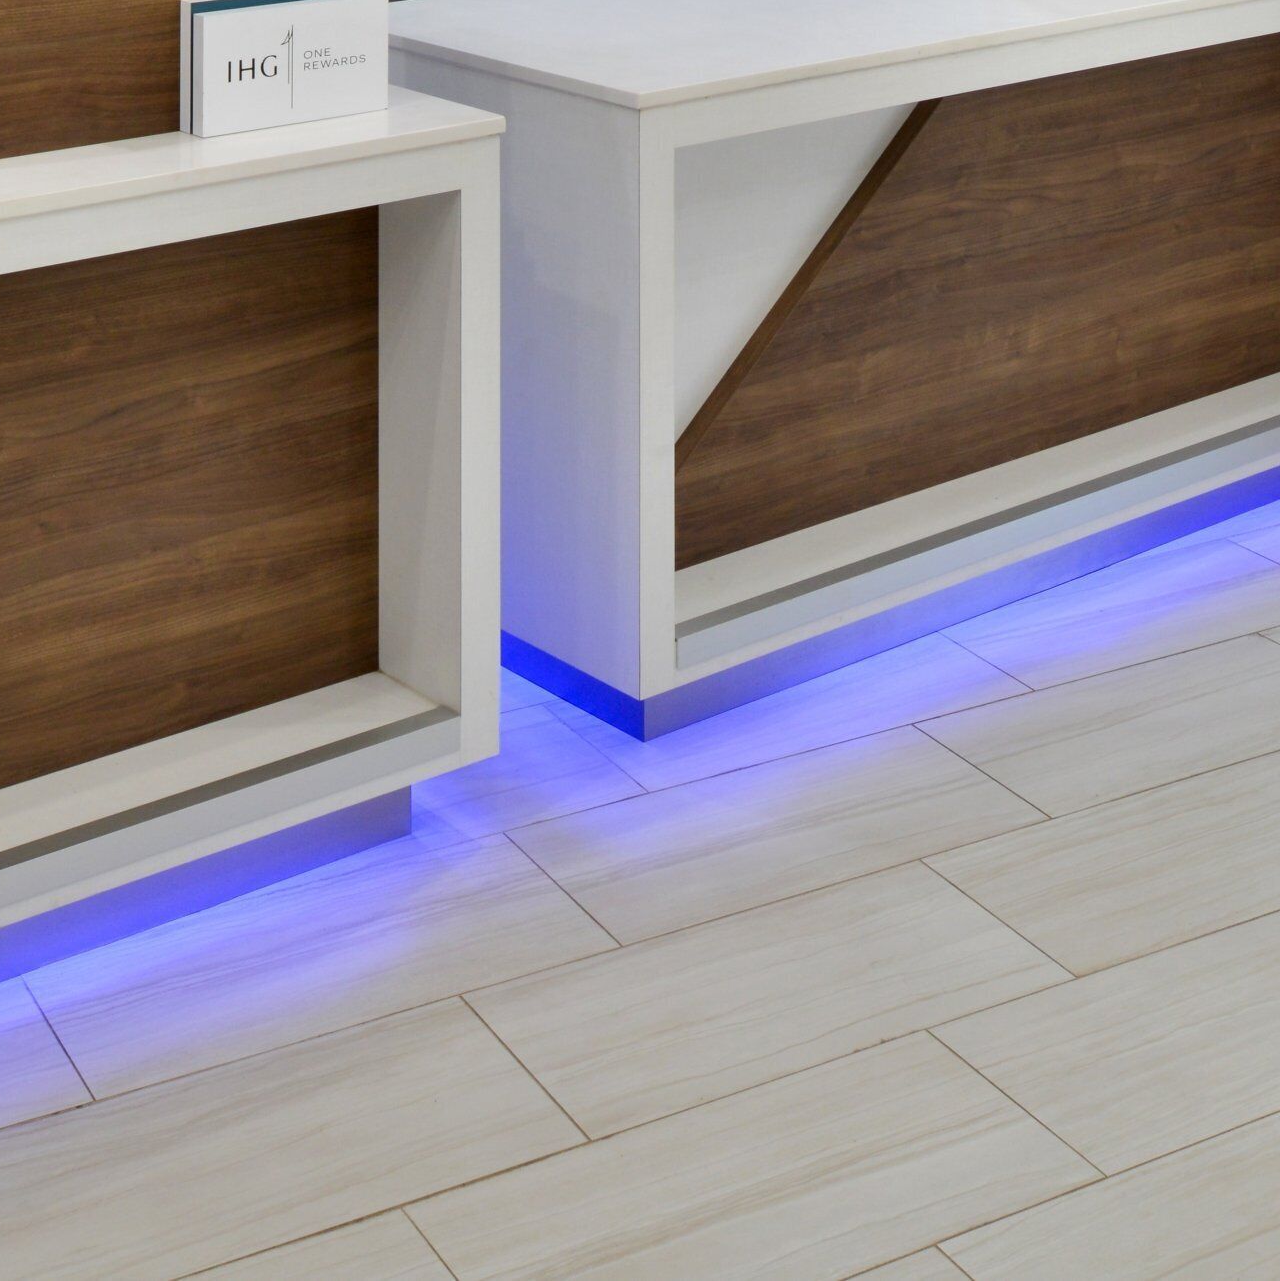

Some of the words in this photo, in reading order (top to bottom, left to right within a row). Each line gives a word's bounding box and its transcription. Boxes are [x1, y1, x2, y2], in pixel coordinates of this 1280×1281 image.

[303, 47, 331, 60] ONE
[228, 55, 278, 83] IHG
[303, 54, 366, 71] REWARDS
